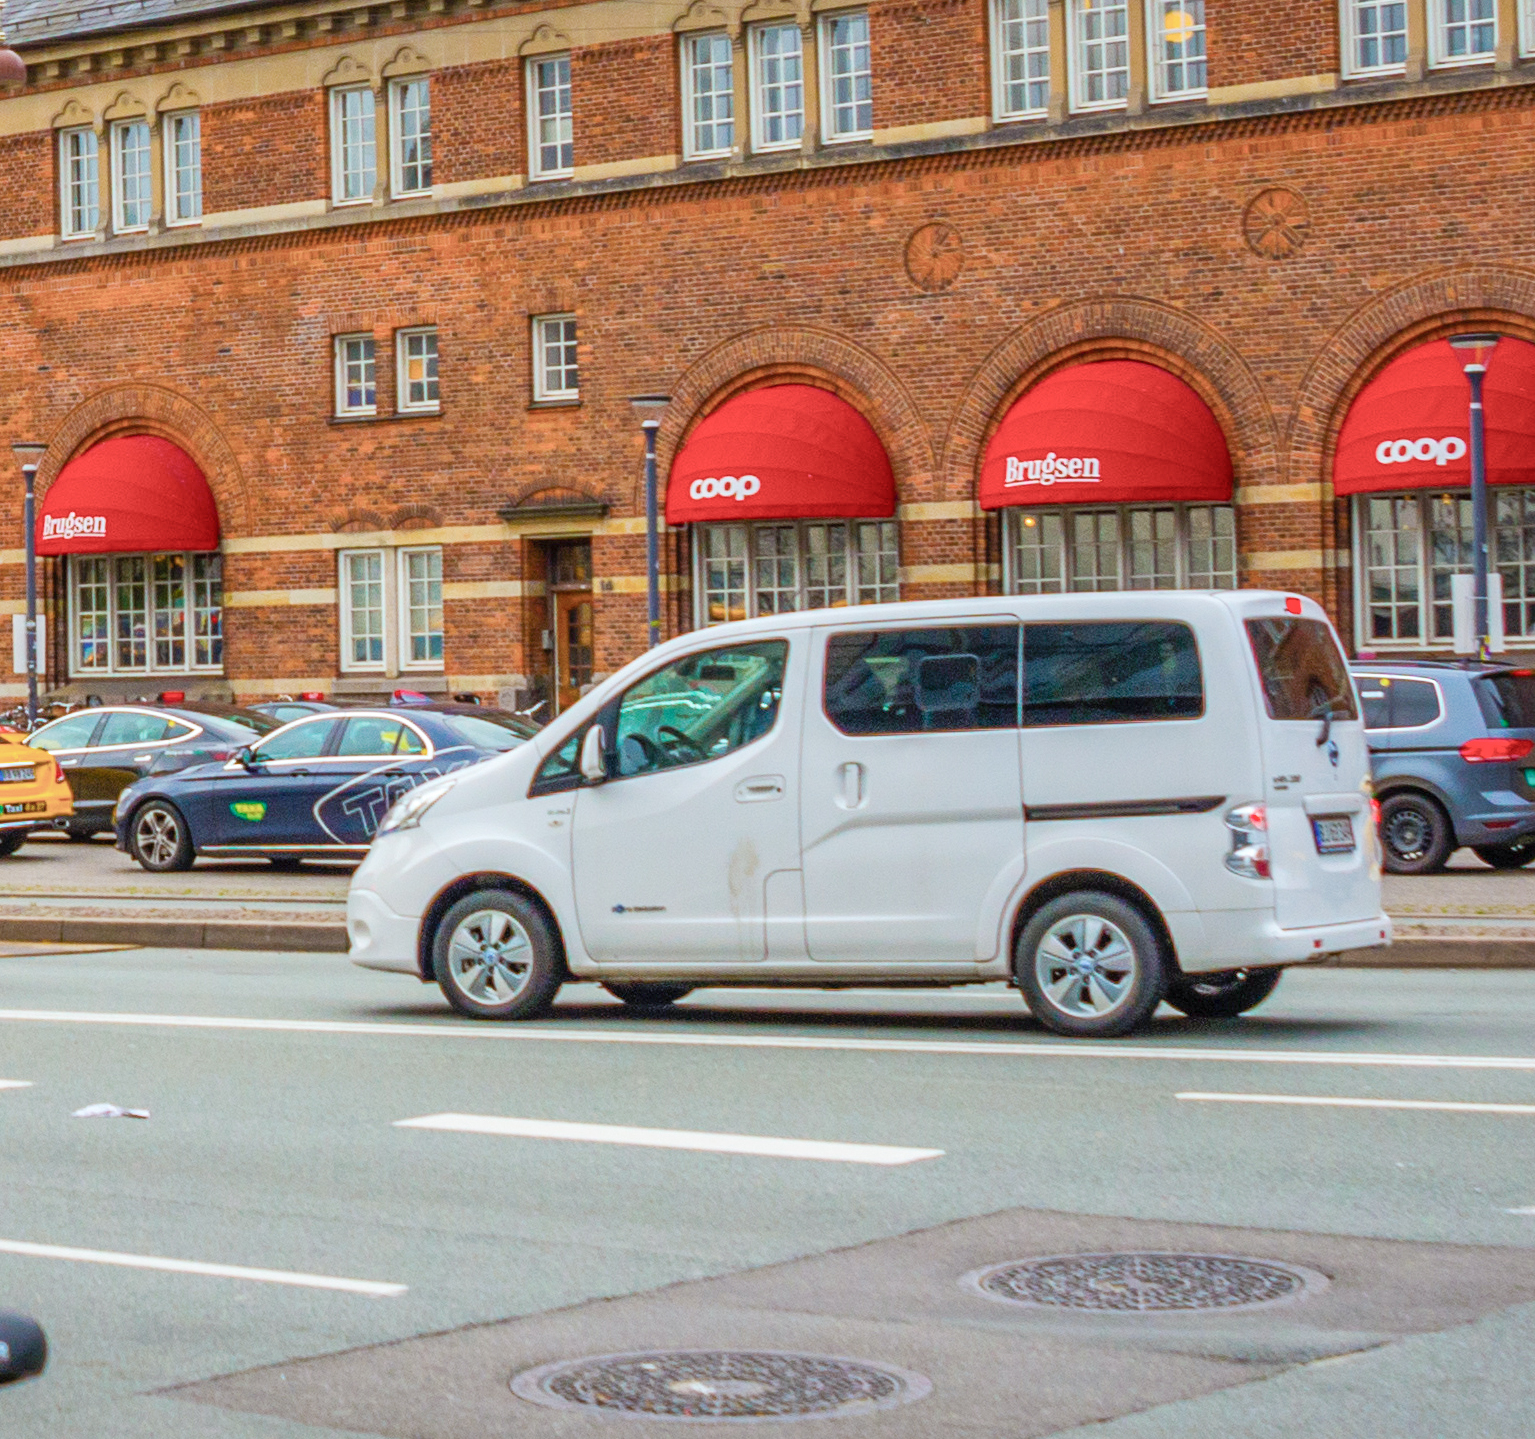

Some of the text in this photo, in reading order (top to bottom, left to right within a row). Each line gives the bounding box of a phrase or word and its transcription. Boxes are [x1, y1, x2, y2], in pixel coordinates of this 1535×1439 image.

[1375, 436, 1467, 466] coop
[1004, 452, 1102, 488] Brugsen
[690, 475, 761, 501] coop
[42, 511, 107, 540] Brugsen
